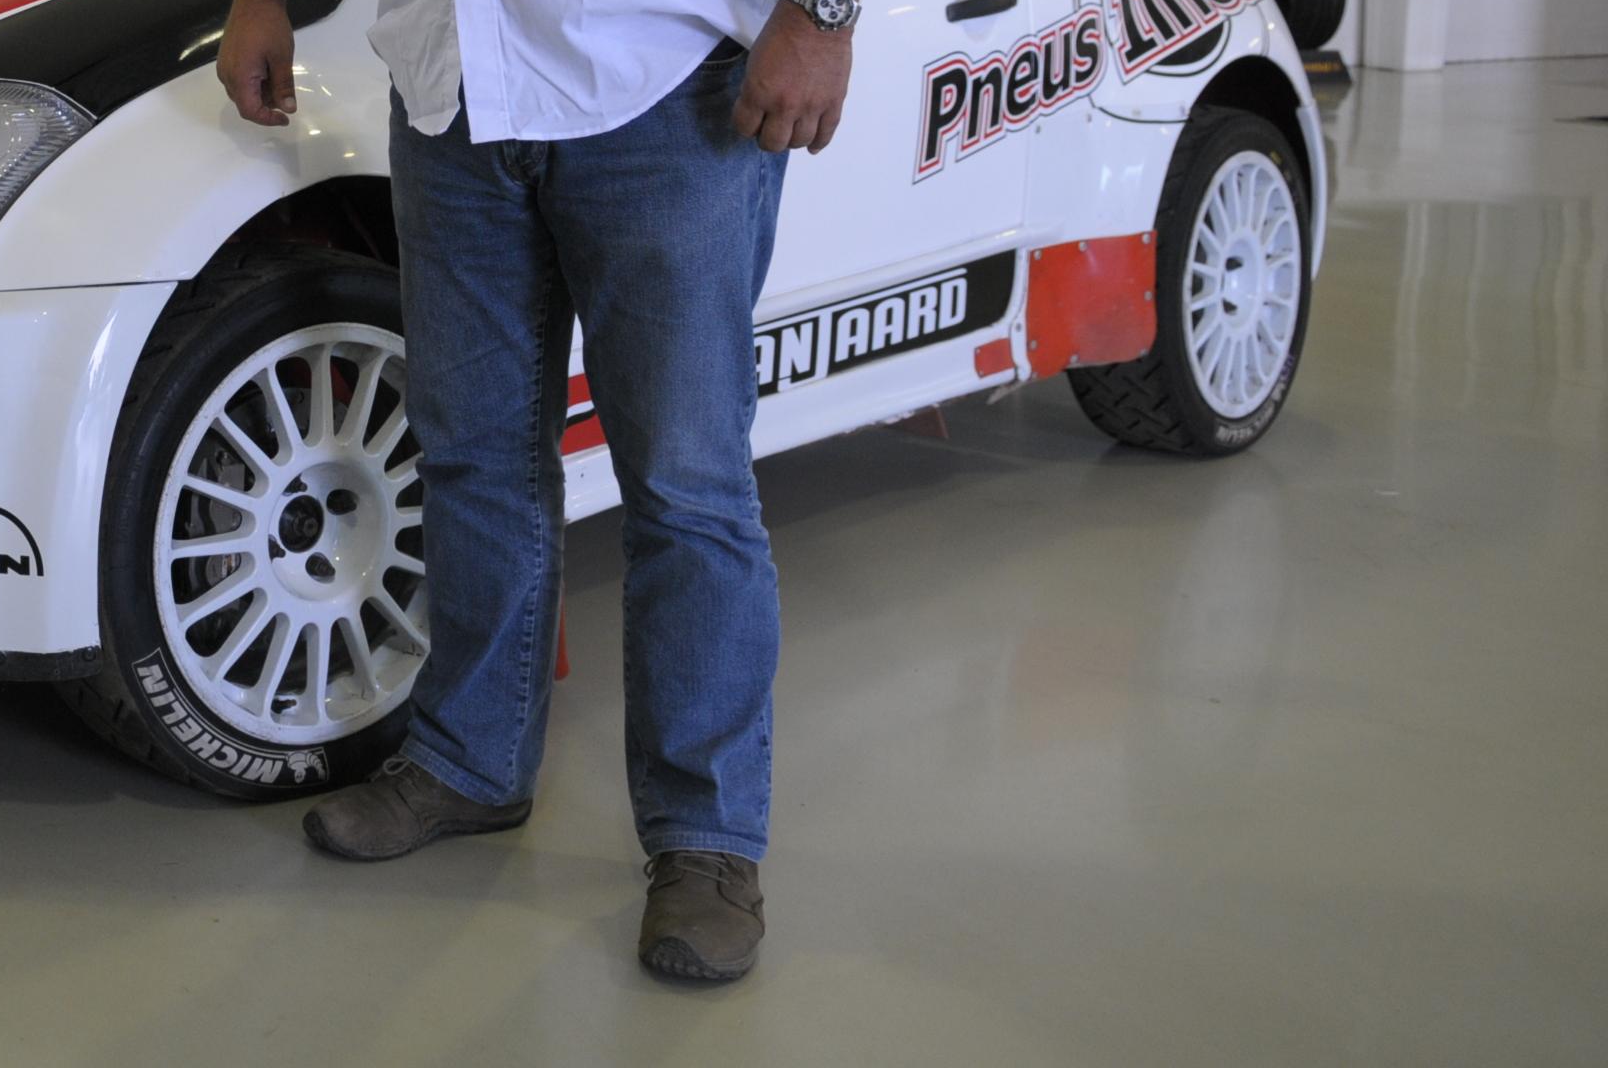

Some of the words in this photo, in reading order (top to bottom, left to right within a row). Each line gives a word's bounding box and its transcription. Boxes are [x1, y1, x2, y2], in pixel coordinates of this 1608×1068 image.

[917, 8, 1104, 174] Pneus
[753, 277, 968, 394] ANJAARD
[137, 663, 284, 783] MICHELIN
